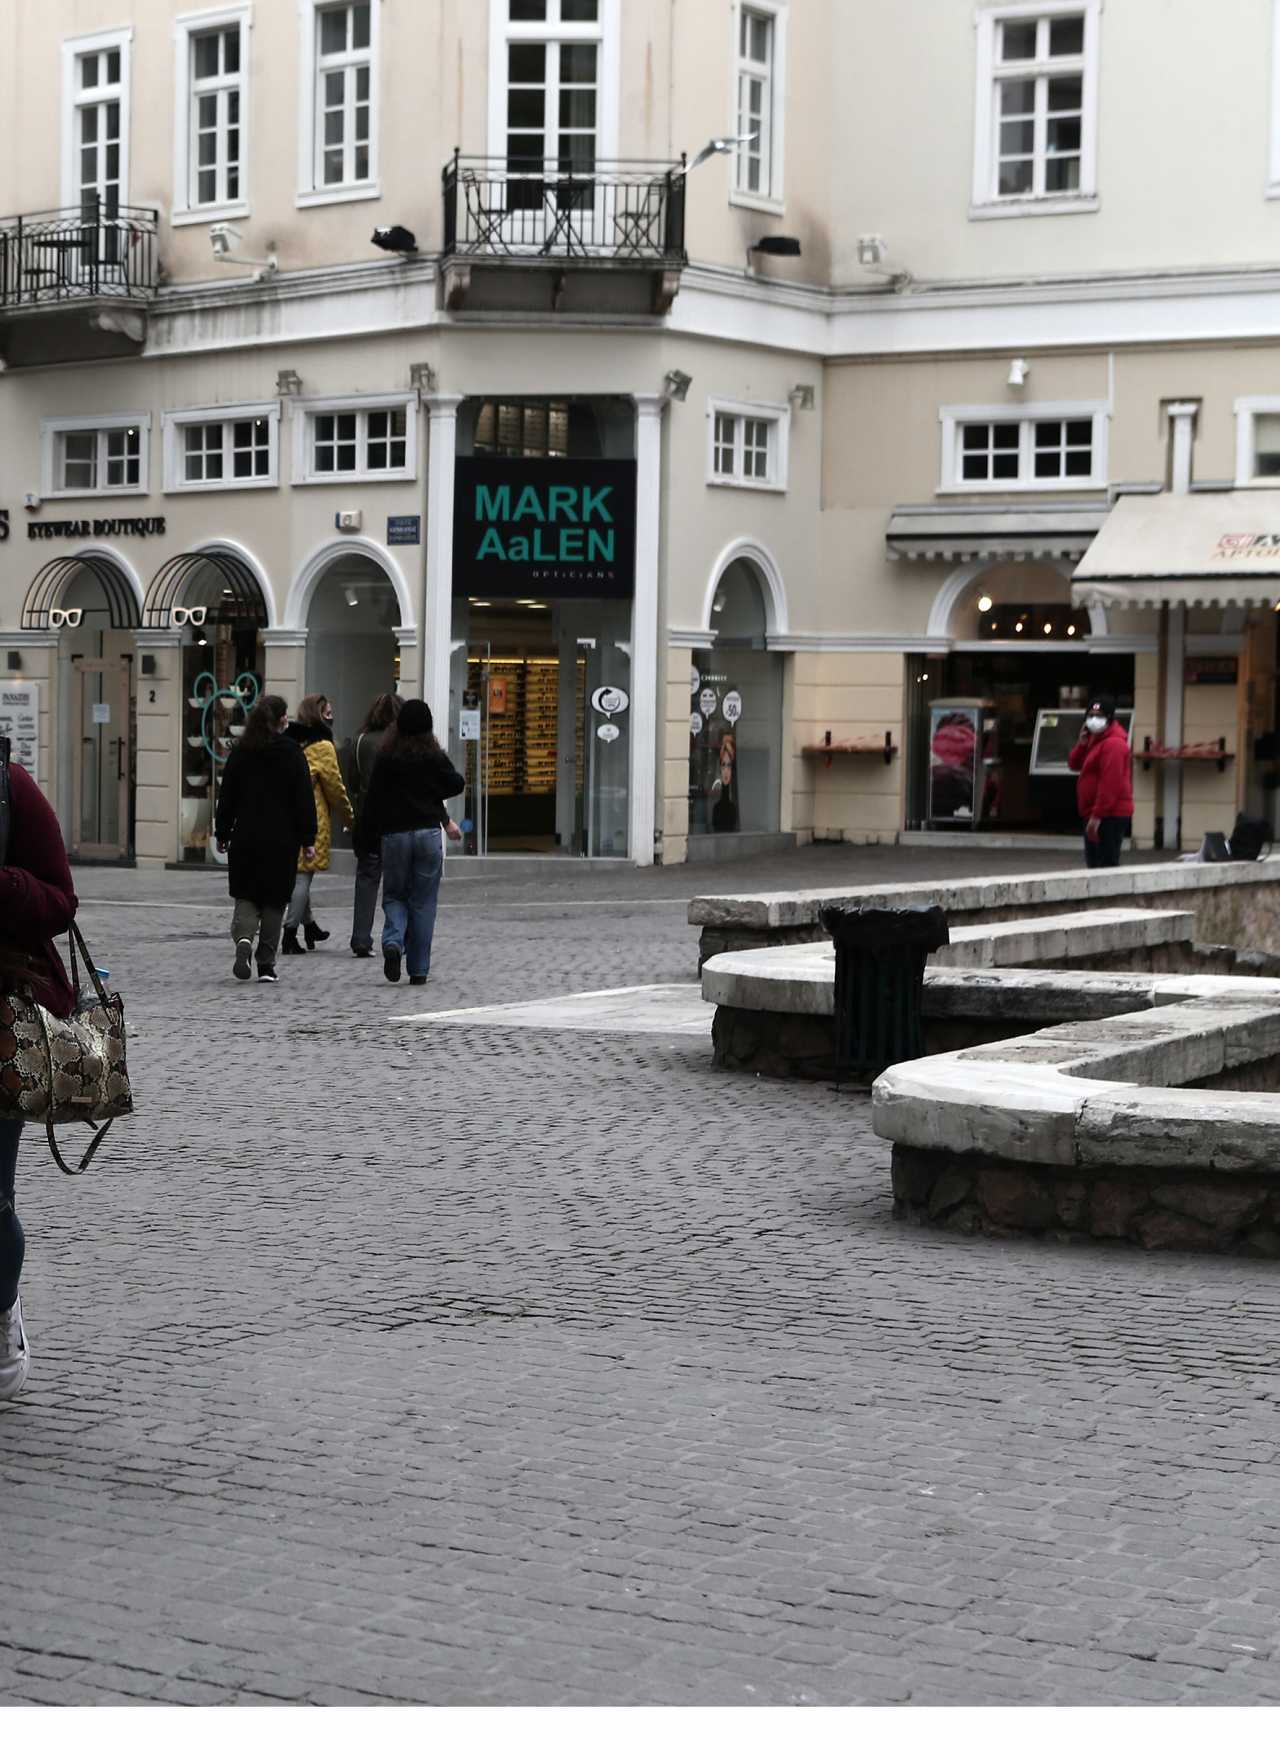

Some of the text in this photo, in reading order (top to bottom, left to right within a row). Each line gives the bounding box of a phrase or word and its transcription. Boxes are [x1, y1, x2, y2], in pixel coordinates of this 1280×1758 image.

[475, 484, 613, 523] MARK
[27, 517, 166, 539] EYEWEAR BOUTIQUE
[475, 527, 614, 562] AaLEN
[149, 690, 157, 703] 2
